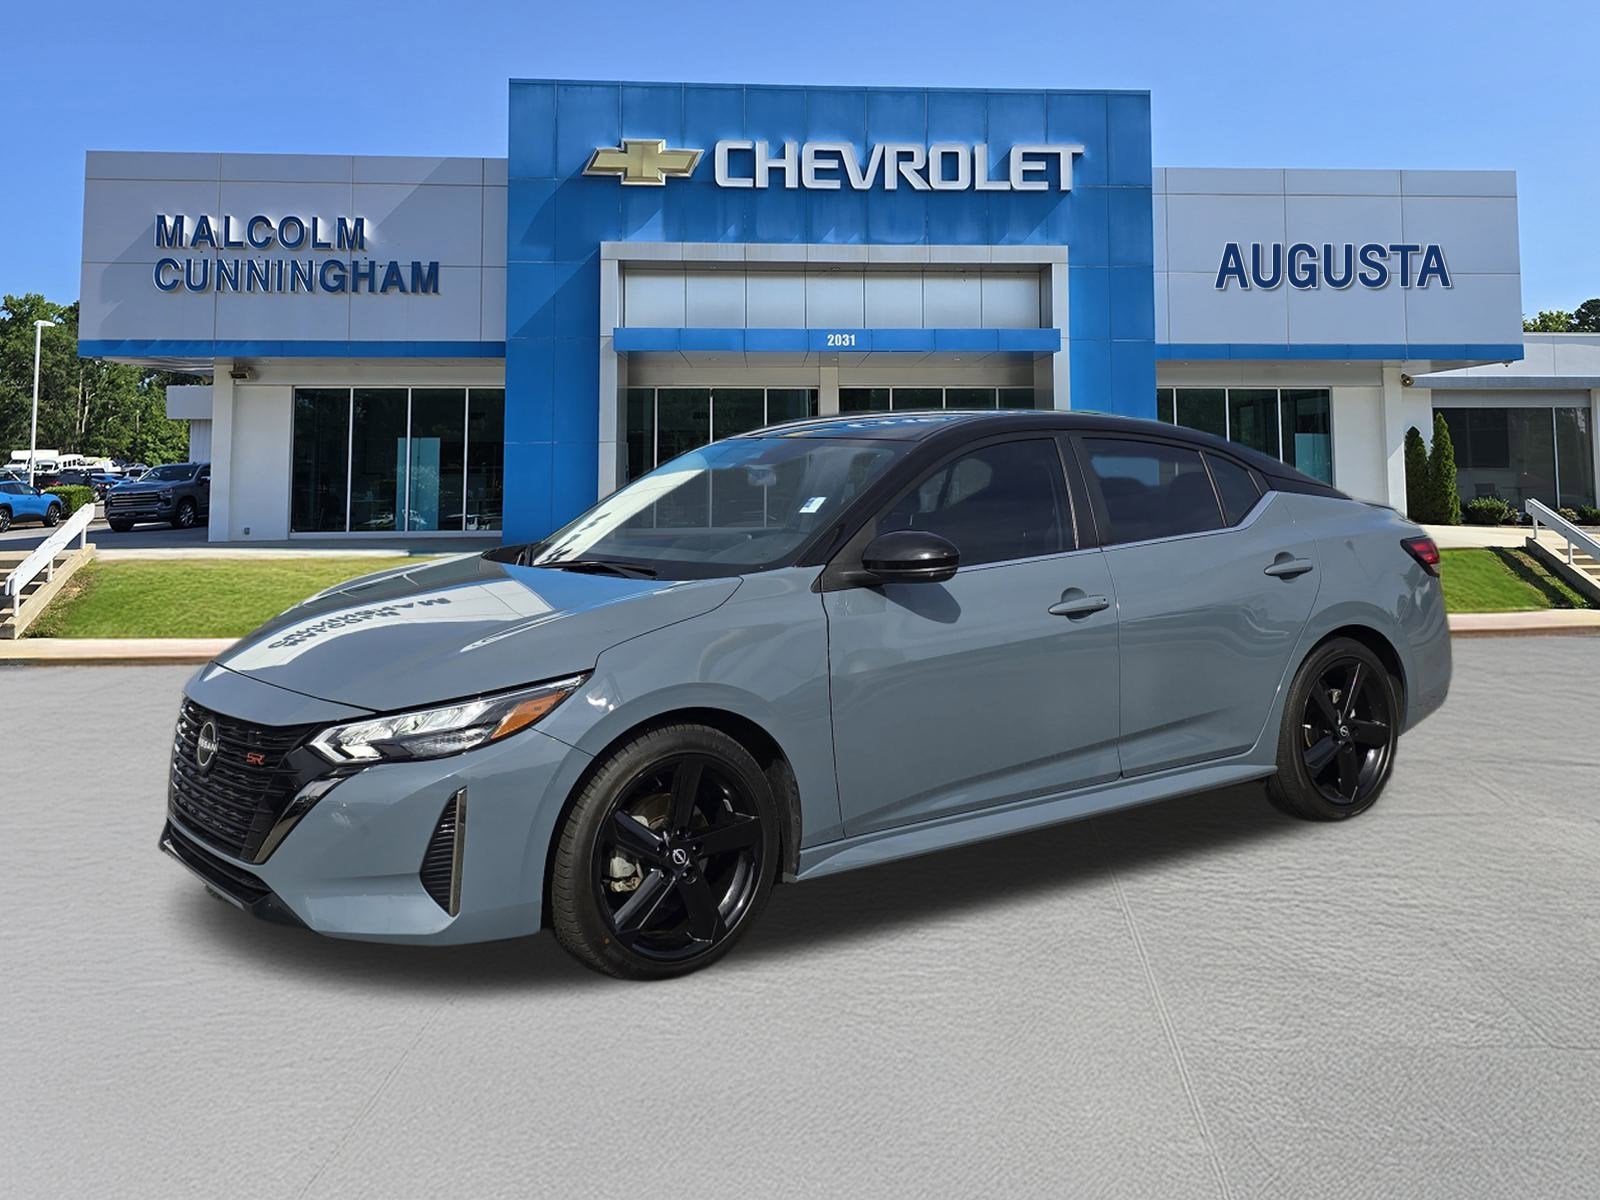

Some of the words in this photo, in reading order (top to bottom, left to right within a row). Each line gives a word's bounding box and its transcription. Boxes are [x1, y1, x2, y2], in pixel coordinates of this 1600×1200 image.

[714, 139, 1085, 192] CHEVROLET
[155, 214, 366, 250] MALCOLM
[153, 257, 441, 294] CUNNINGHAM
[1214, 241, 1452, 290] AUGUSTA
[826, 333, 856, 347] 2031
